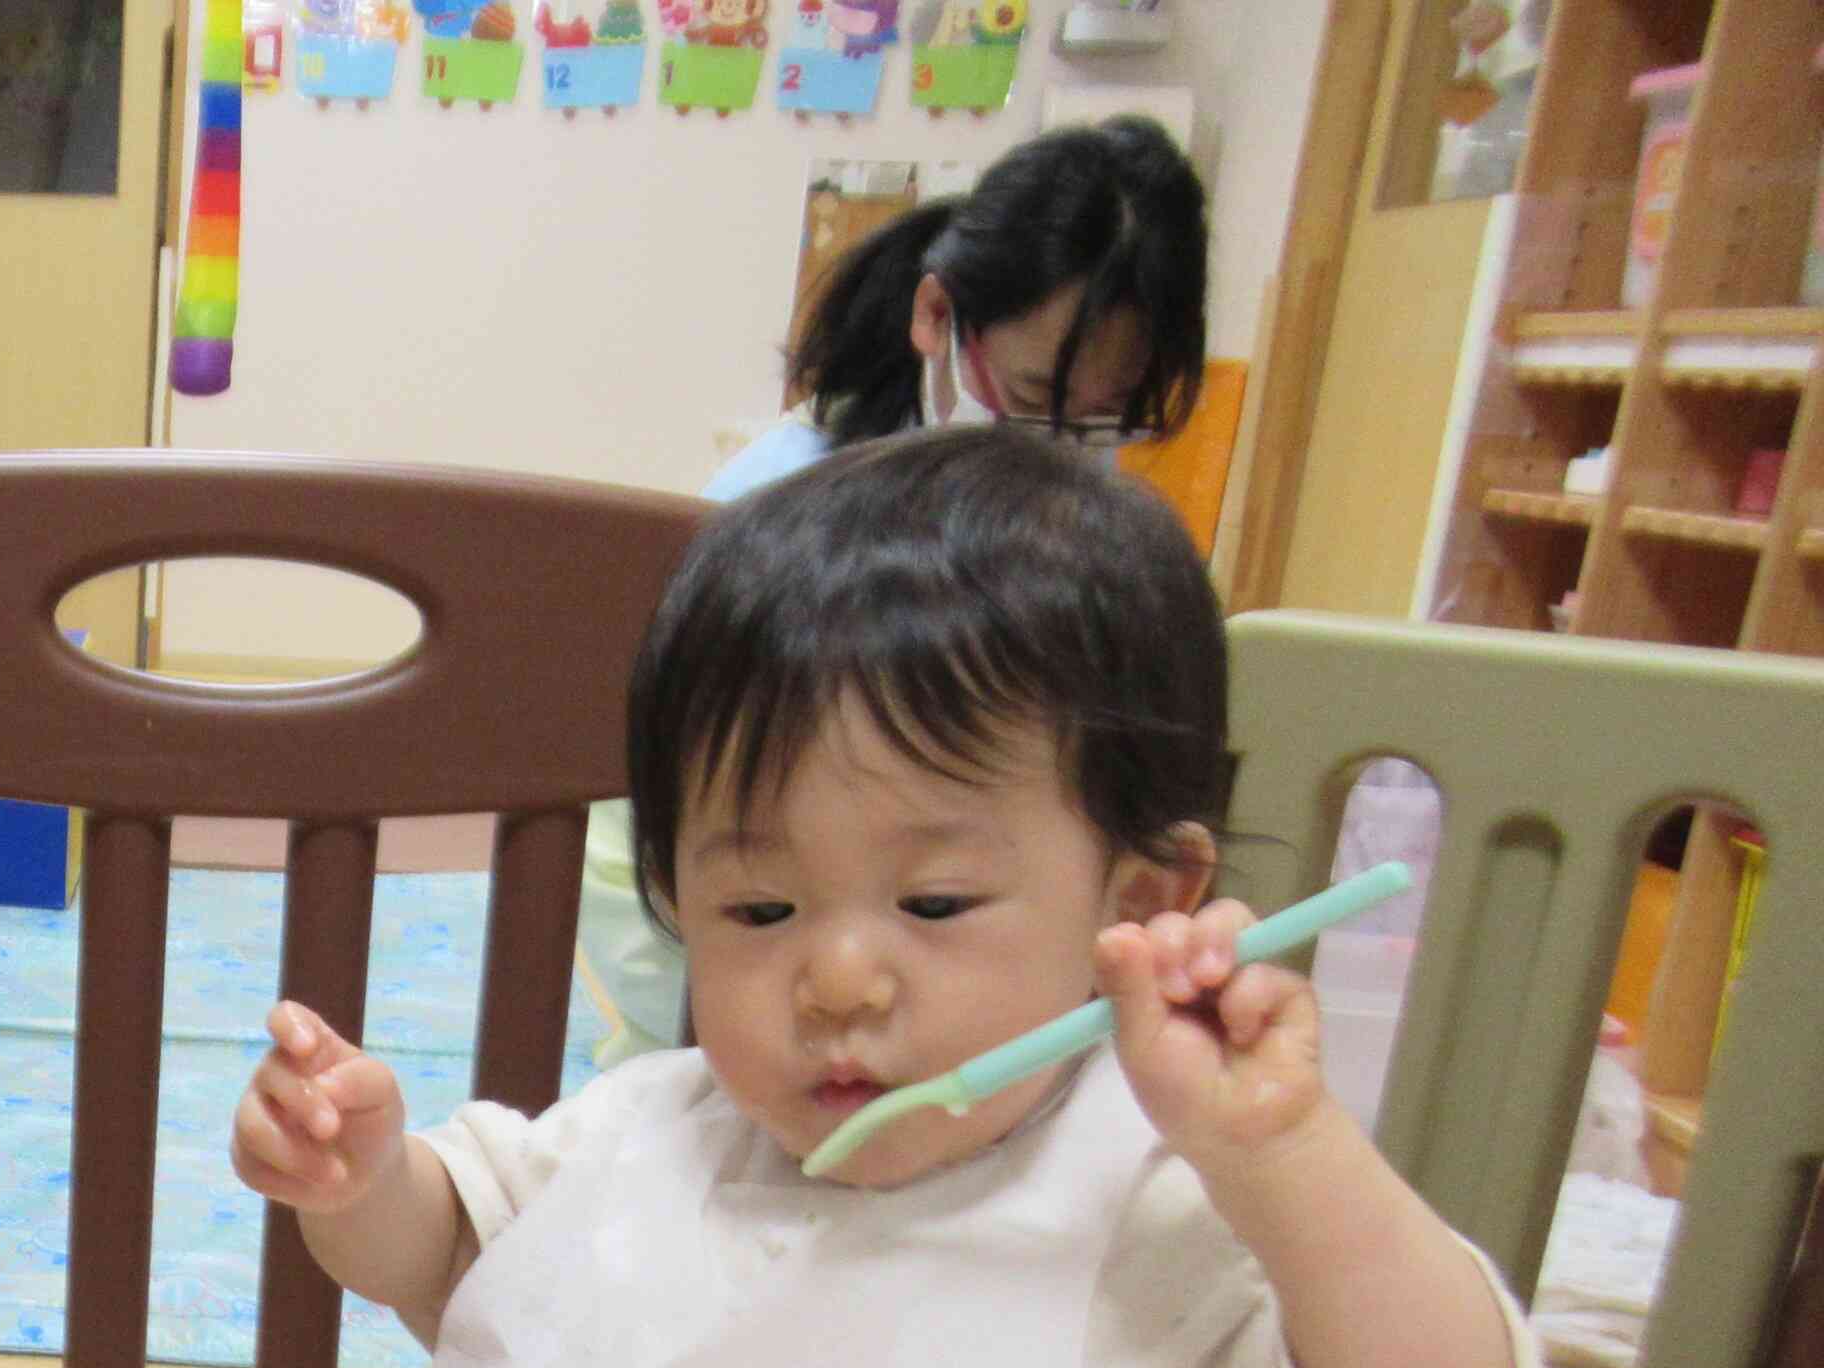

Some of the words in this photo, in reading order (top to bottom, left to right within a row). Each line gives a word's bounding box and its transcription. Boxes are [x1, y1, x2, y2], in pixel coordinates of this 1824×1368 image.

[425, 54, 447, 81] 11
[547, 62, 570, 89] 12
[781, 63, 801, 90] 2
